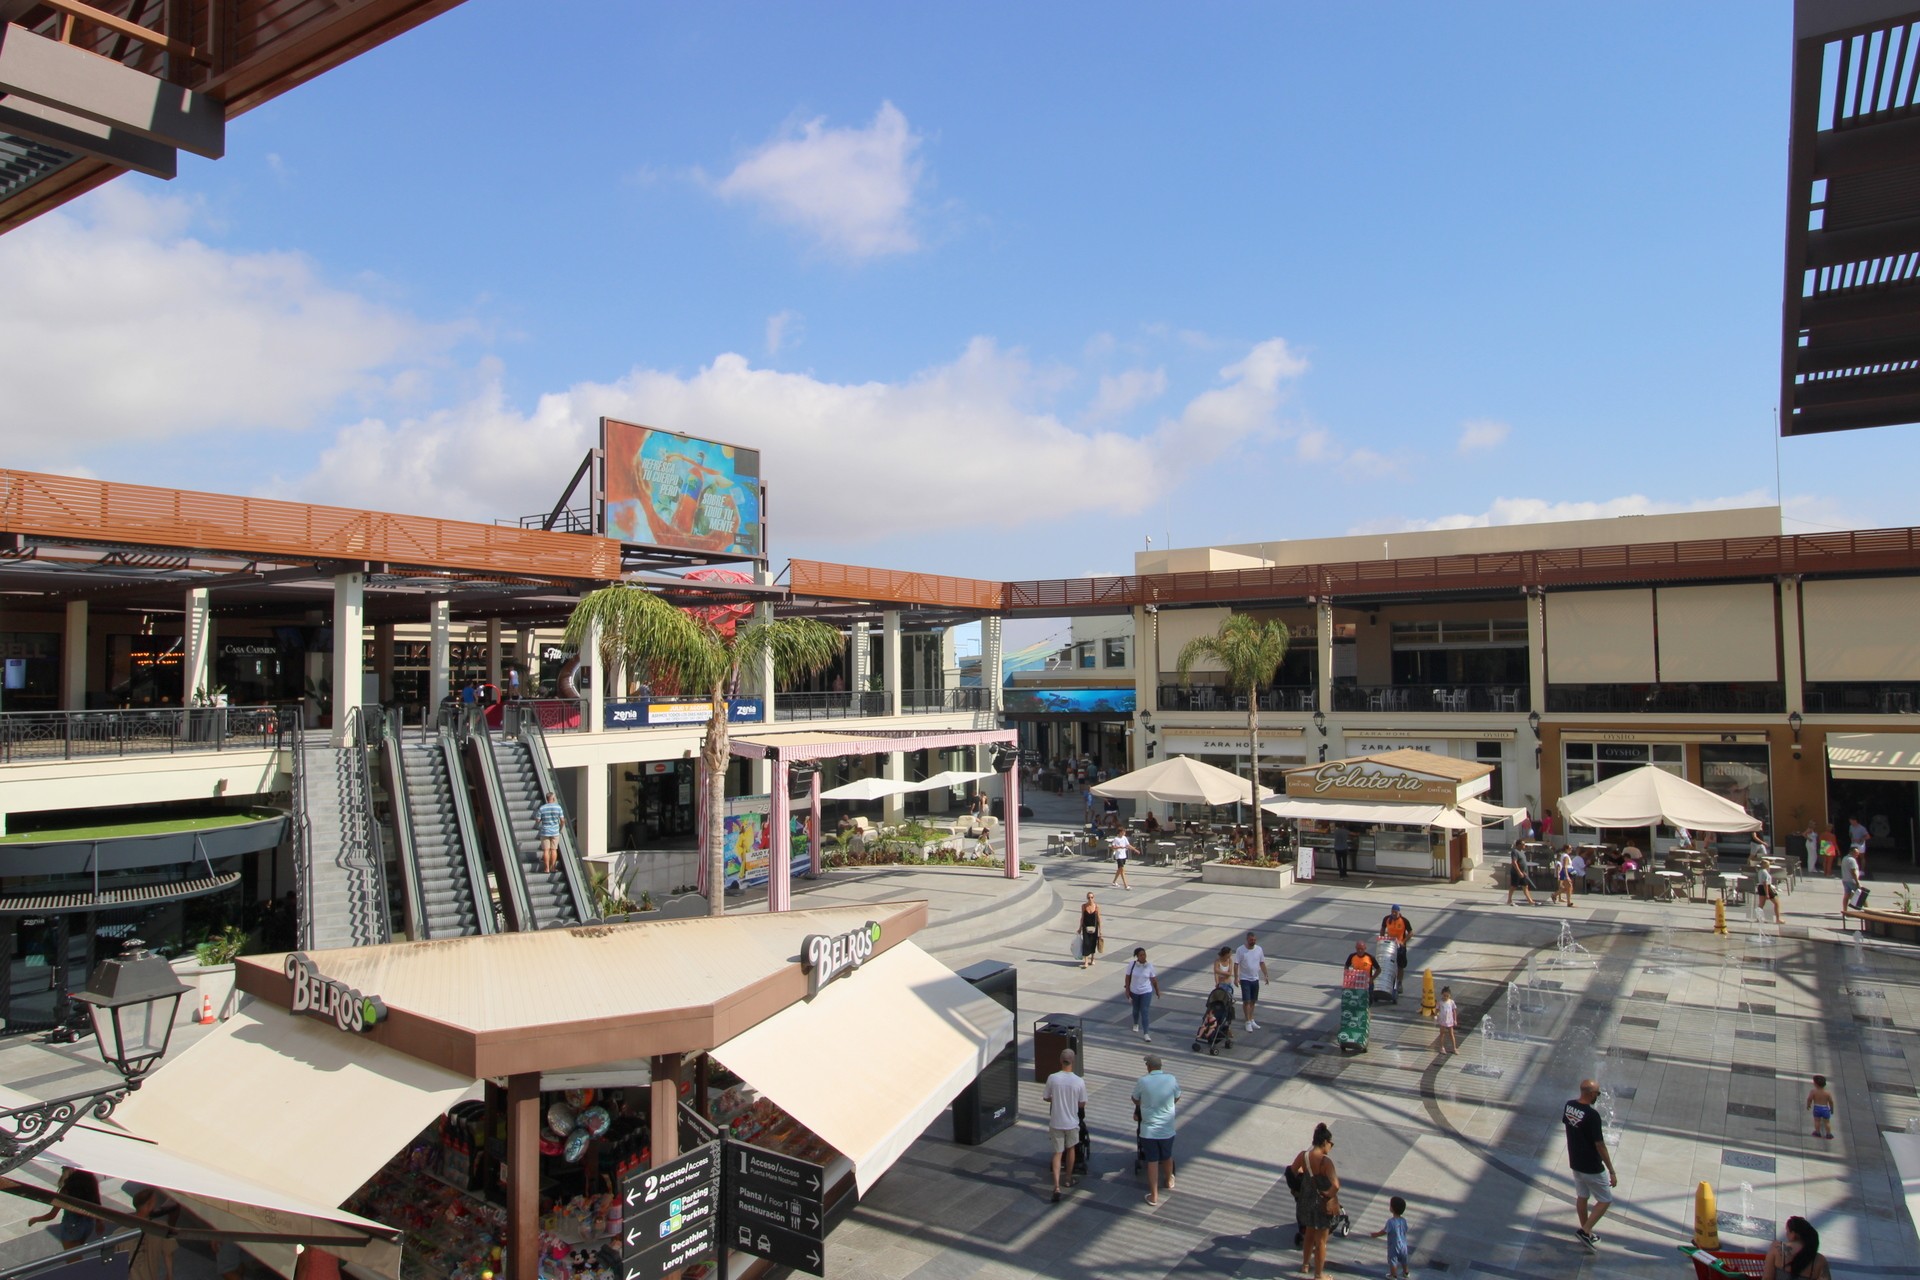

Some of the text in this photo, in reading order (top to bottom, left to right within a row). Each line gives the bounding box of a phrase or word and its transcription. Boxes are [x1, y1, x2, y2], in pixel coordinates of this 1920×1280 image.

[642, 459, 676, 474] REFRESCA
[642, 470, 679, 486] TU CUERPO
[660, 485, 679, 497] PERO
[702, 493, 726, 508] SOBRE
[704, 506, 734, 520] TODO TU
[709, 518, 735, 533] MENTE
[613, 709, 638, 721] zenia
[736, 705, 757, 716] zenia
[1605, 748, 1641, 757] OYSHO
[1315, 762, 1423, 793] Gelateria
[1566, 1105, 1585, 1119] VANS
[659, 1157, 709, 1184] Acceso/Access
[740, 1151, 748, 1175] 1
[750, 1156, 800, 1178] Acceso/Access
[659, 1170, 700, 1194] Puerta Mar Menor
[750, 1167, 766, 1177] Puerta
[765, 1171, 778, 1181] Mare
[645, 1175, 658, 1202] 2
[681, 1187, 709, 1206] Parking
[739, 1186, 762, 1201] Planta
[768, 1197, 784, 1208] Floor
[784, 1200, 789, 1210] 1
[681, 1205, 709, 1224] Parking
[738, 1200, 786, 1223] Restauración
[671, 1228, 708, 1253] Decathlon
[662, 1241, 708, 1271] Leroy Merlin
